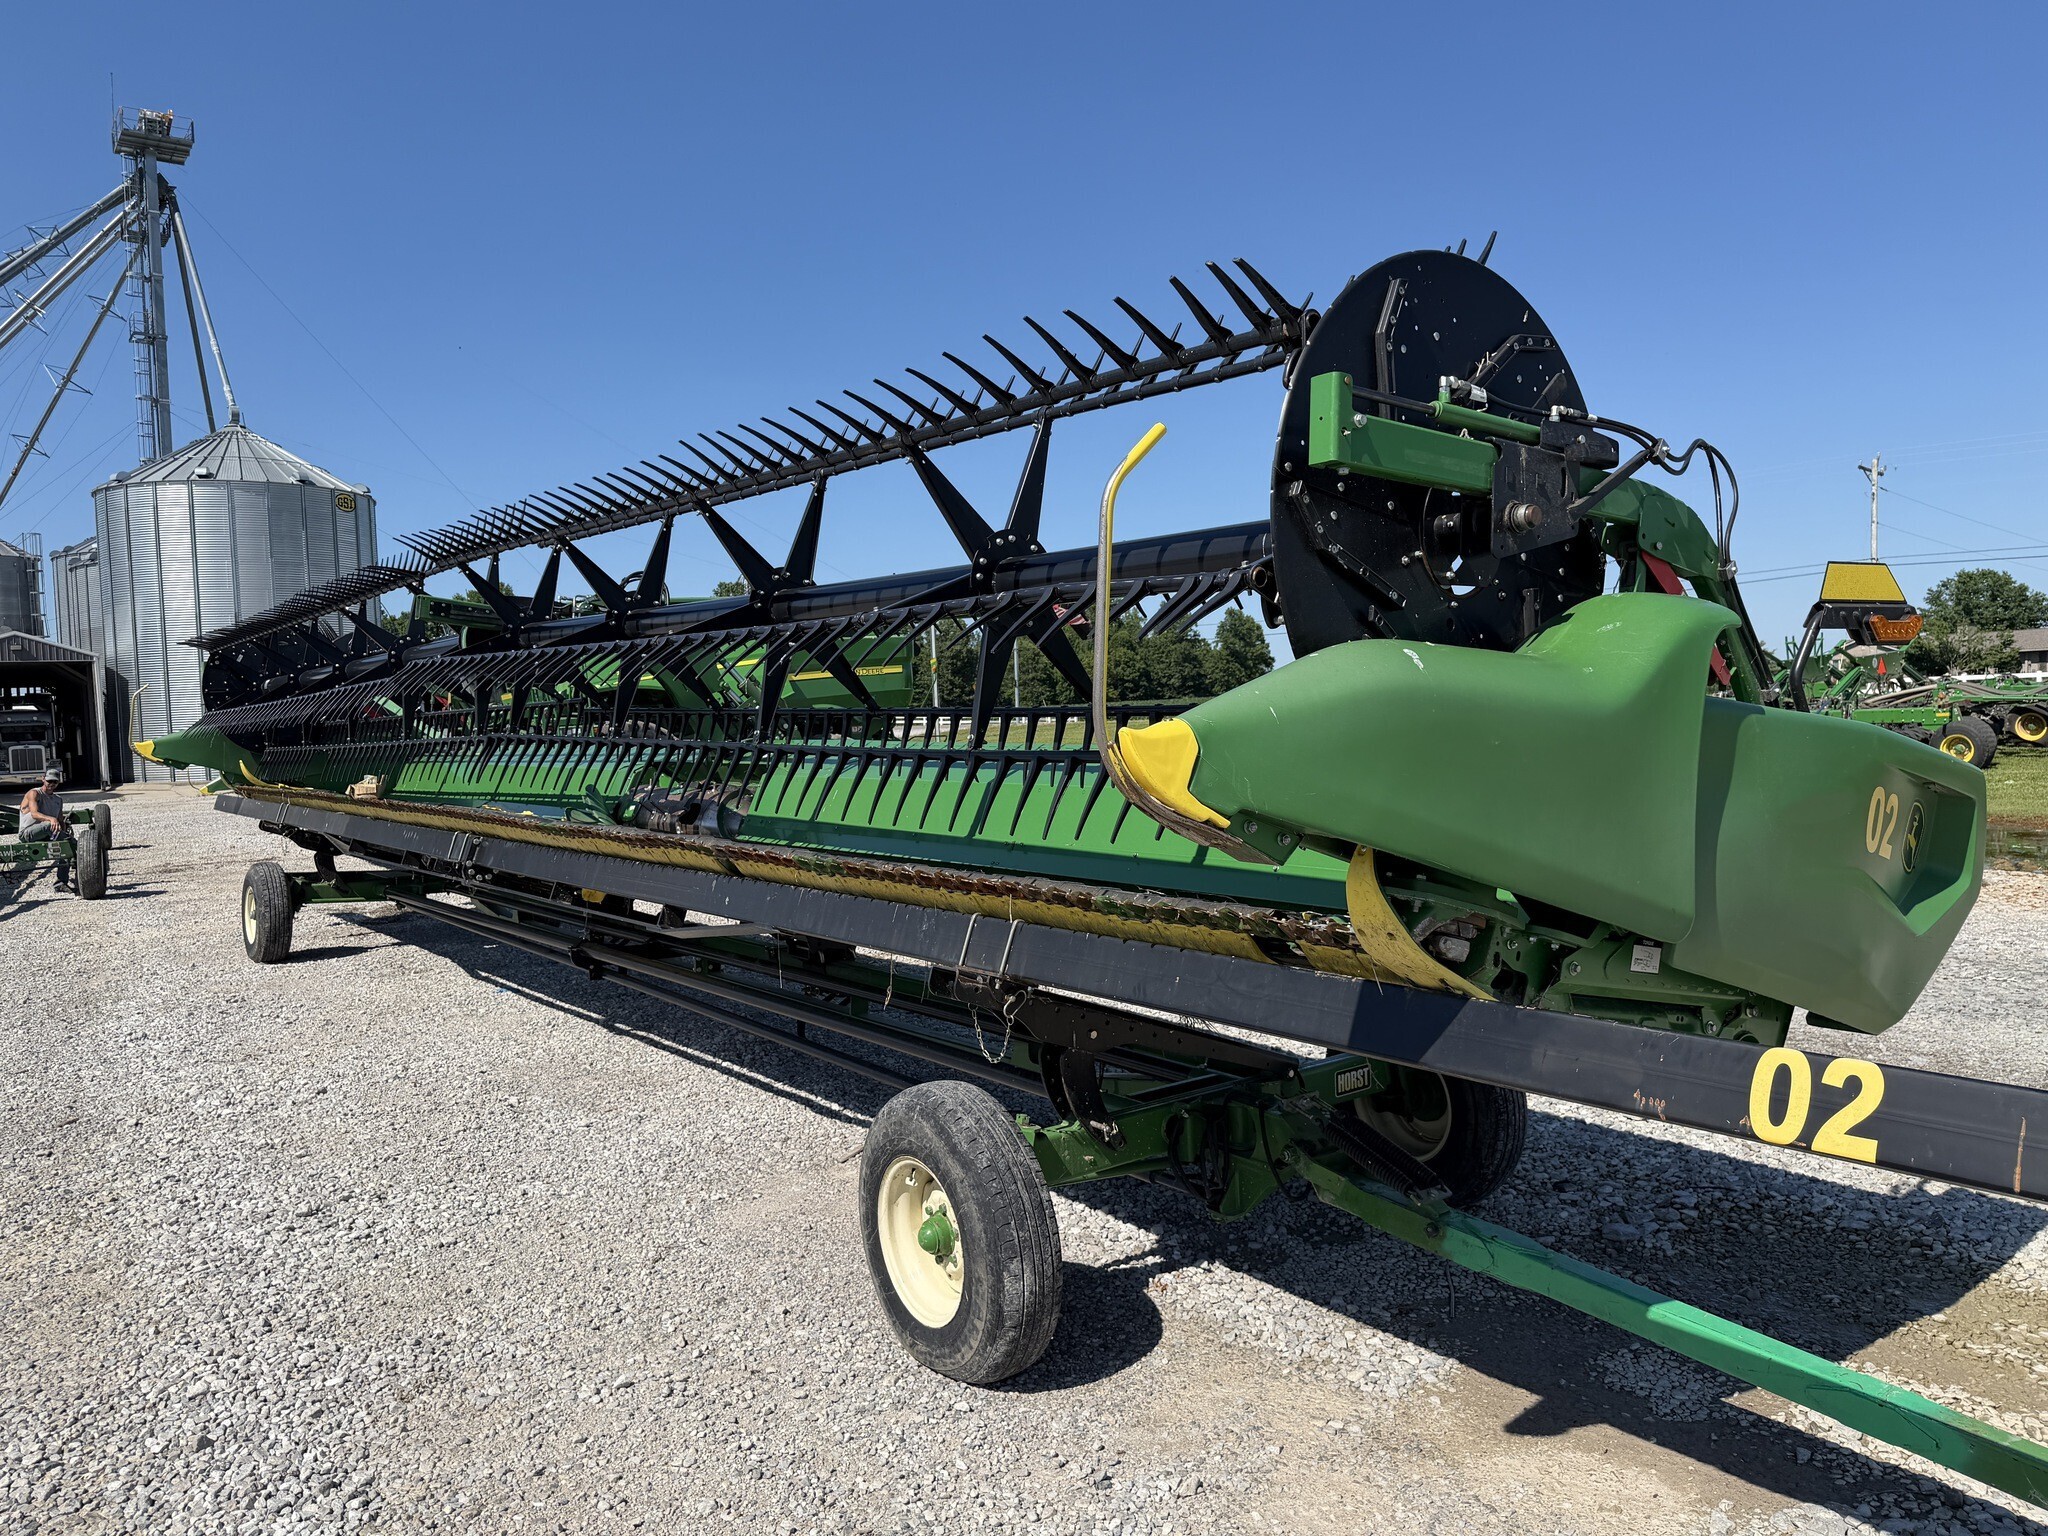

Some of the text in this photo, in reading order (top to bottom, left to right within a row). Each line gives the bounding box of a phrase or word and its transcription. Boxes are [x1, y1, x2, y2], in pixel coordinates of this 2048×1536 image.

[337, 496, 354, 509] GSI
[862, 666, 886, 675] DEERE
[1866, 786, 1899, 860] 02
[1337, 1067, 1369, 1093] HORST
[1749, 1047, 1885, 1163] 02
